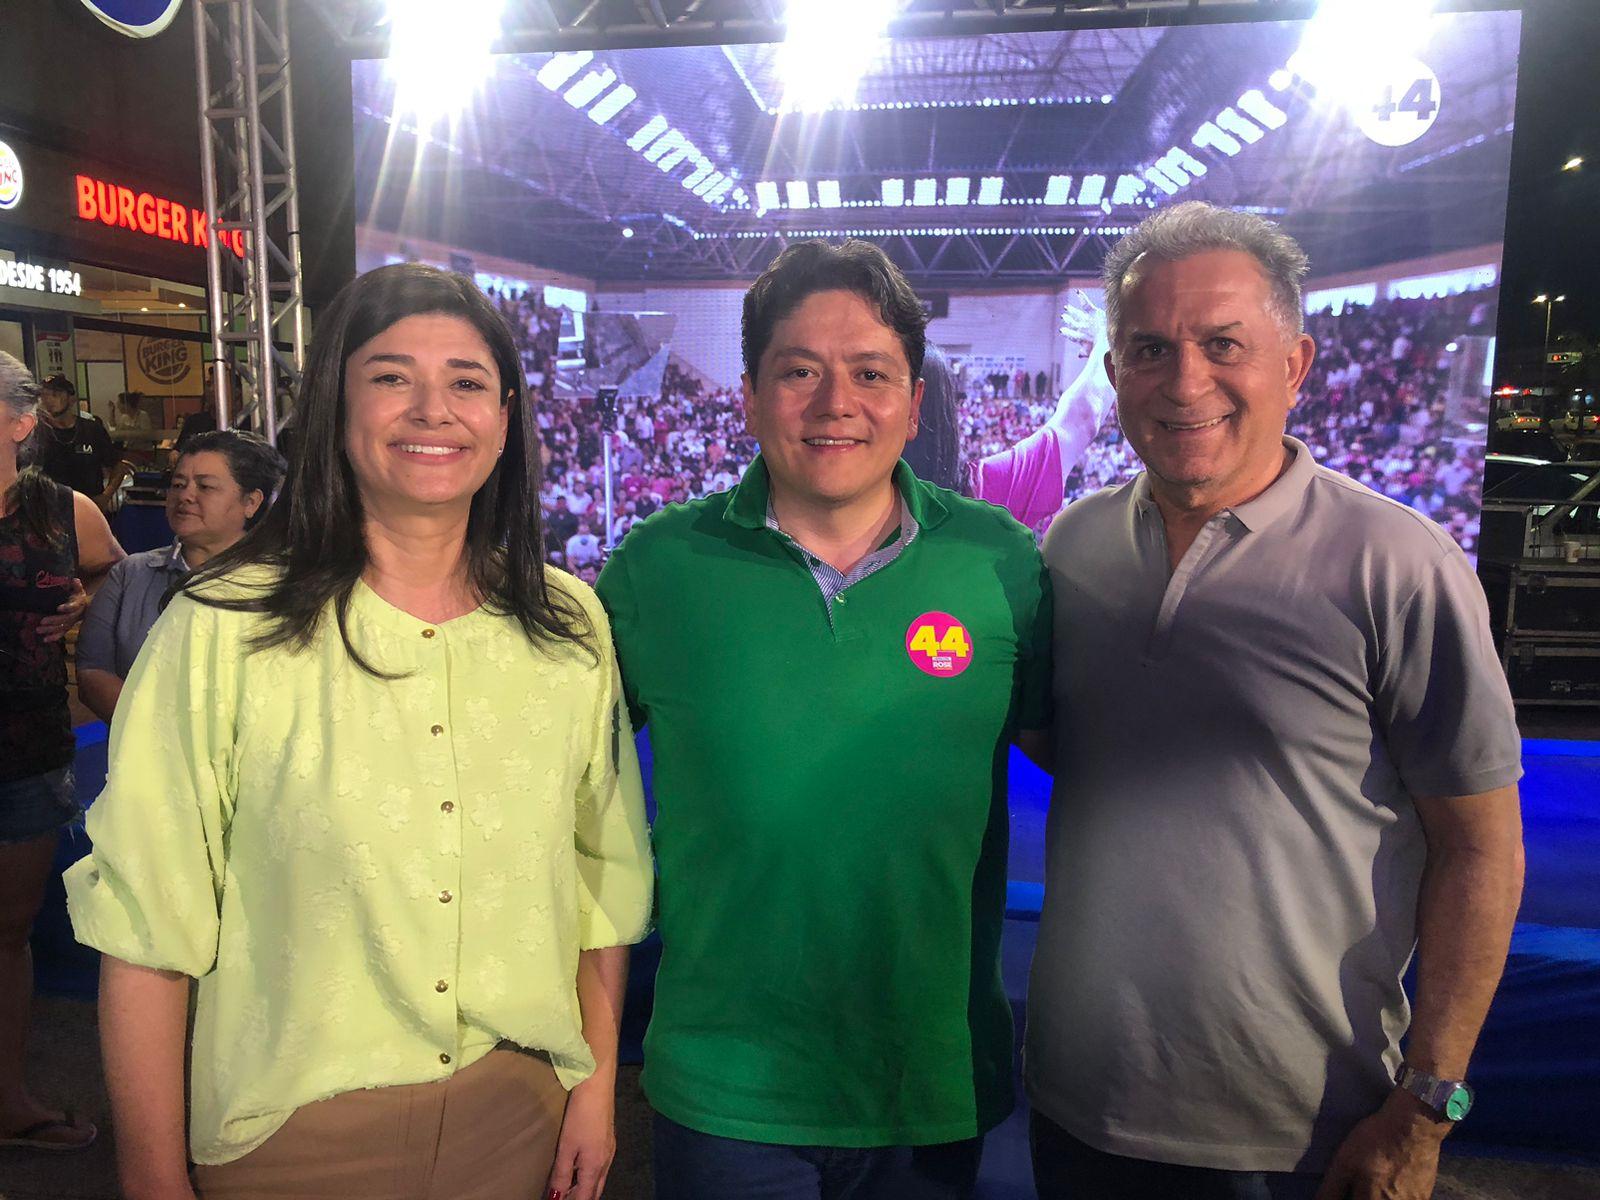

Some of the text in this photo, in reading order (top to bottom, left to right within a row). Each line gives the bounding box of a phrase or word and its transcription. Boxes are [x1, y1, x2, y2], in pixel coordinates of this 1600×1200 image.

[76, 174, 245, 258] BURGER KNG
[0, 259, 82, 296] DESDE 1954
[143, 338, 185, 359] BURGER
[145, 346, 188, 374] KING
[909, 625, 969, 658] 44
